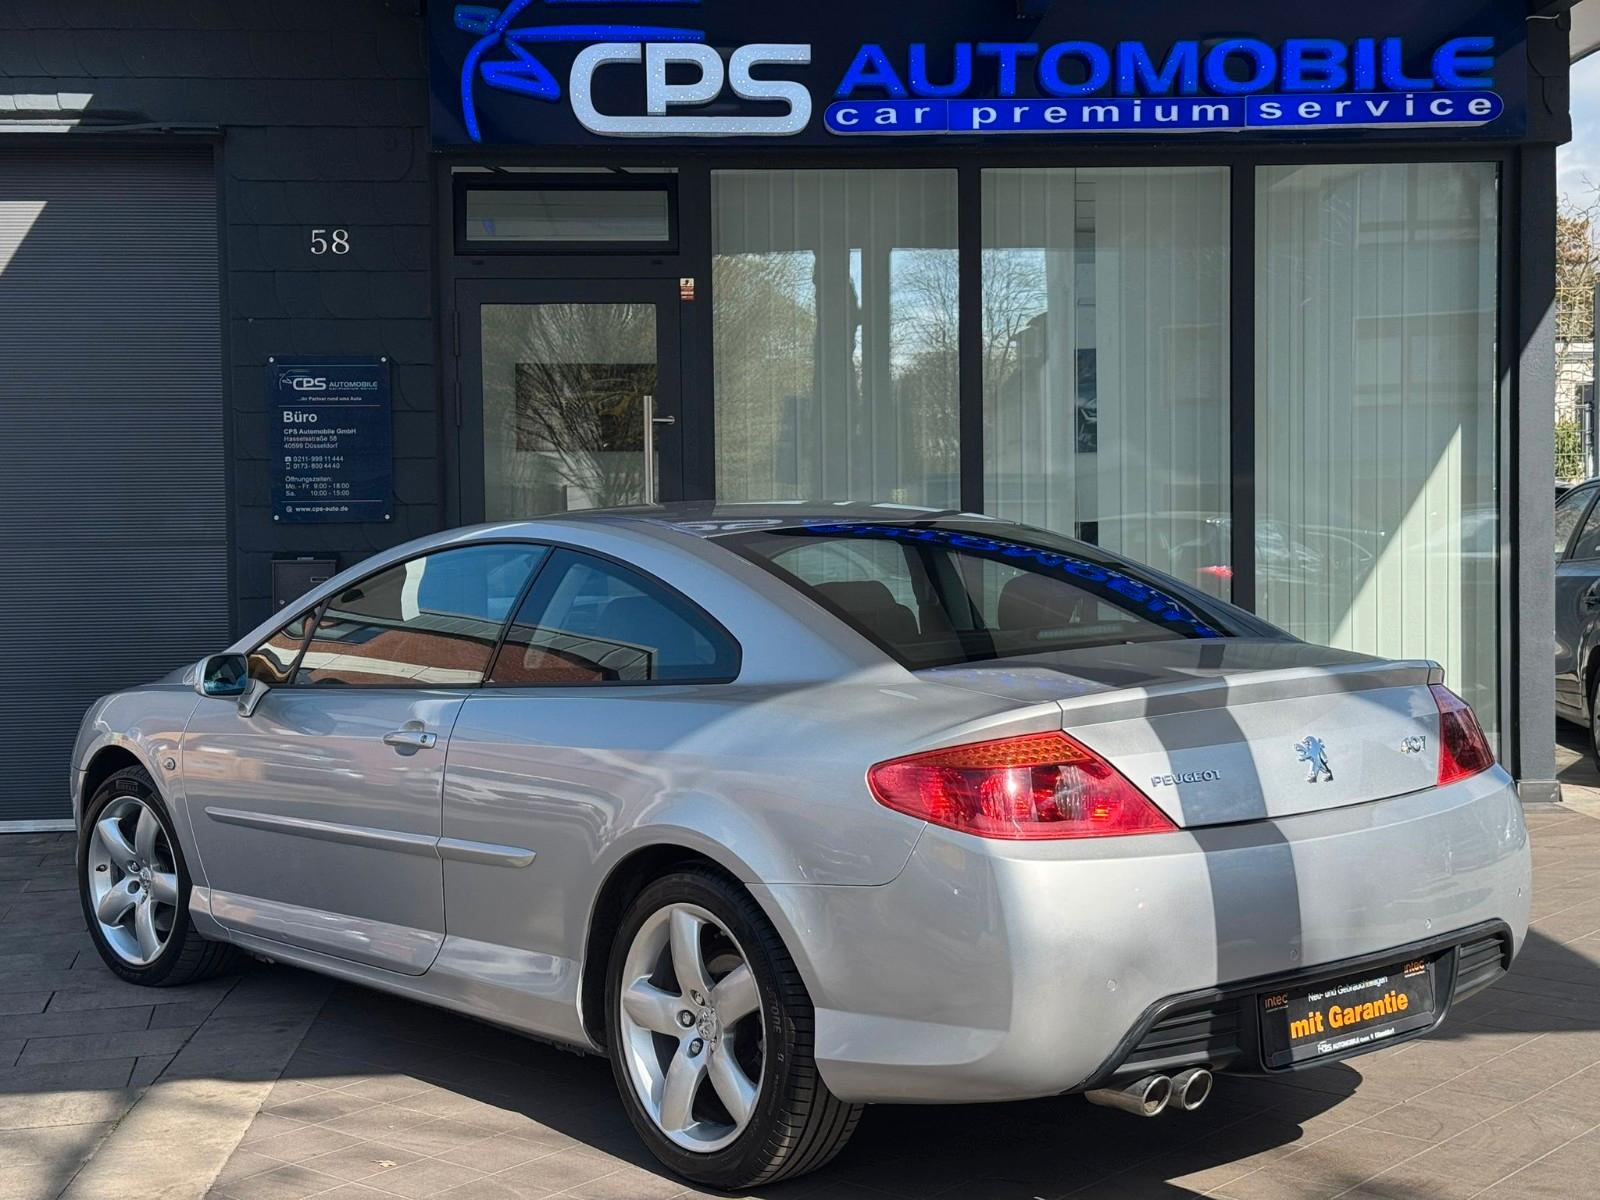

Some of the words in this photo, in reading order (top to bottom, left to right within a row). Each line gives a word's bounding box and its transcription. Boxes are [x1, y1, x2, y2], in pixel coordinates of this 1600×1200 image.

[569, 42, 812, 137] CPS
[836, 36, 1496, 97] AUTOMOBILE
[835, 104, 930, 126] car
[971, 99, 1230, 129] premium
[1259, 95, 1492, 120] service
[310, 229, 350, 255] 58
[293, 378, 326, 390] CPS
[283, 411, 318, 423] Büro
[298, 427, 336, 435] Automobile
[295, 505, 349, 513] www.cps-auto.de
[1151, 769, 1222, 788] PEUGEOT
[1404, 960, 1425, 973] intec
[1264, 993, 1288, 1009] intec
[1290, 1009, 1325, 1039] mit
[1328, 990, 1409, 1029] Garantie
